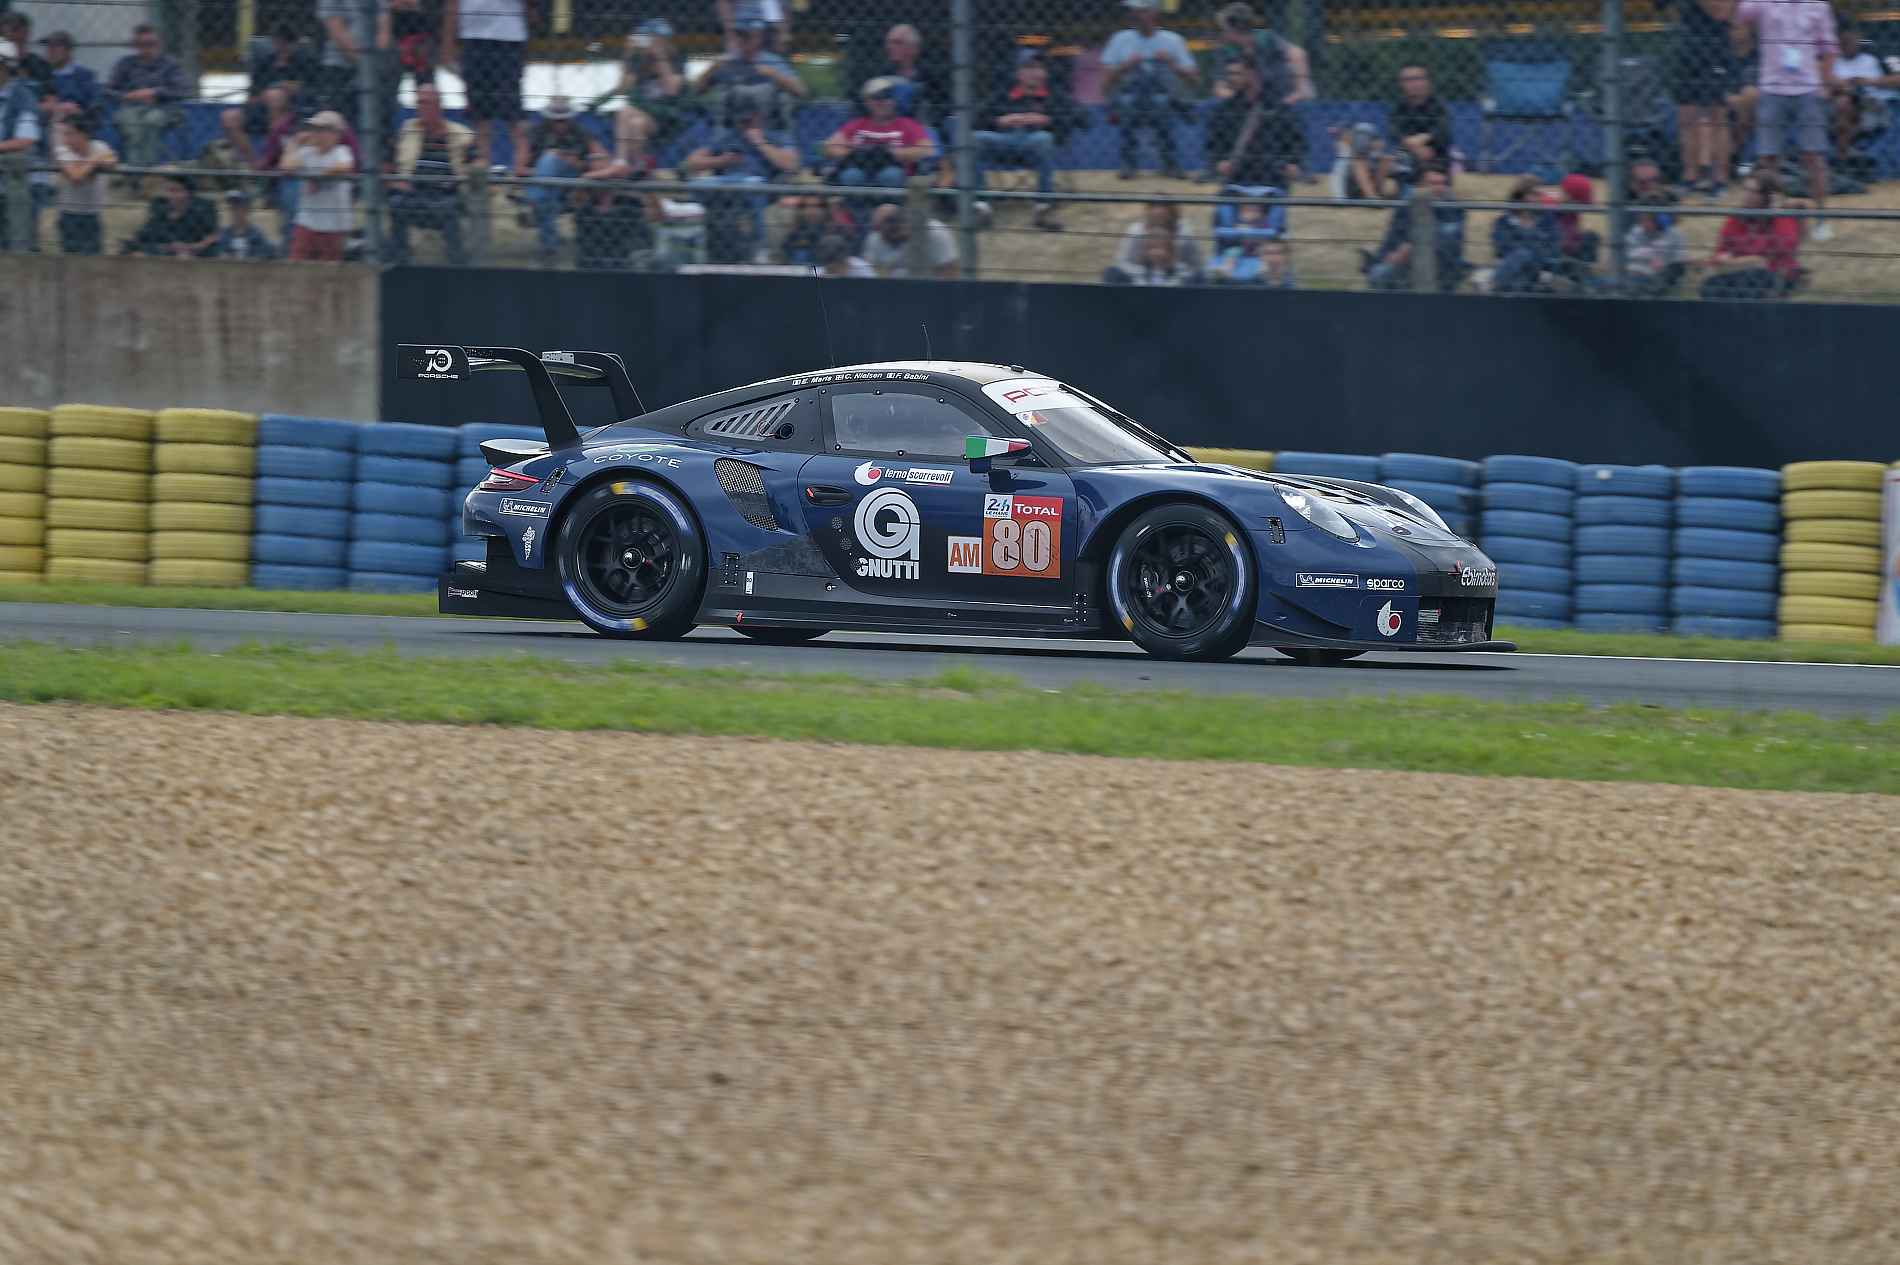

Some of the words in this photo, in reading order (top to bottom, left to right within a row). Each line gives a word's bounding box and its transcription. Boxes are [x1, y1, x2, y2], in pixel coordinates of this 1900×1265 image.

[425, 349, 453, 372] 70
[593, 454, 682, 469] COYOTE
[513, 504, 546, 513] MICHELIN
[992, 519, 1052, 572] 80
[949, 542, 980, 568] AM
[856, 558, 920, 580] GNUTTI
[1314, 576, 1354, 585] MICHELIN
[1366, 578, 1405, 591] sparco
